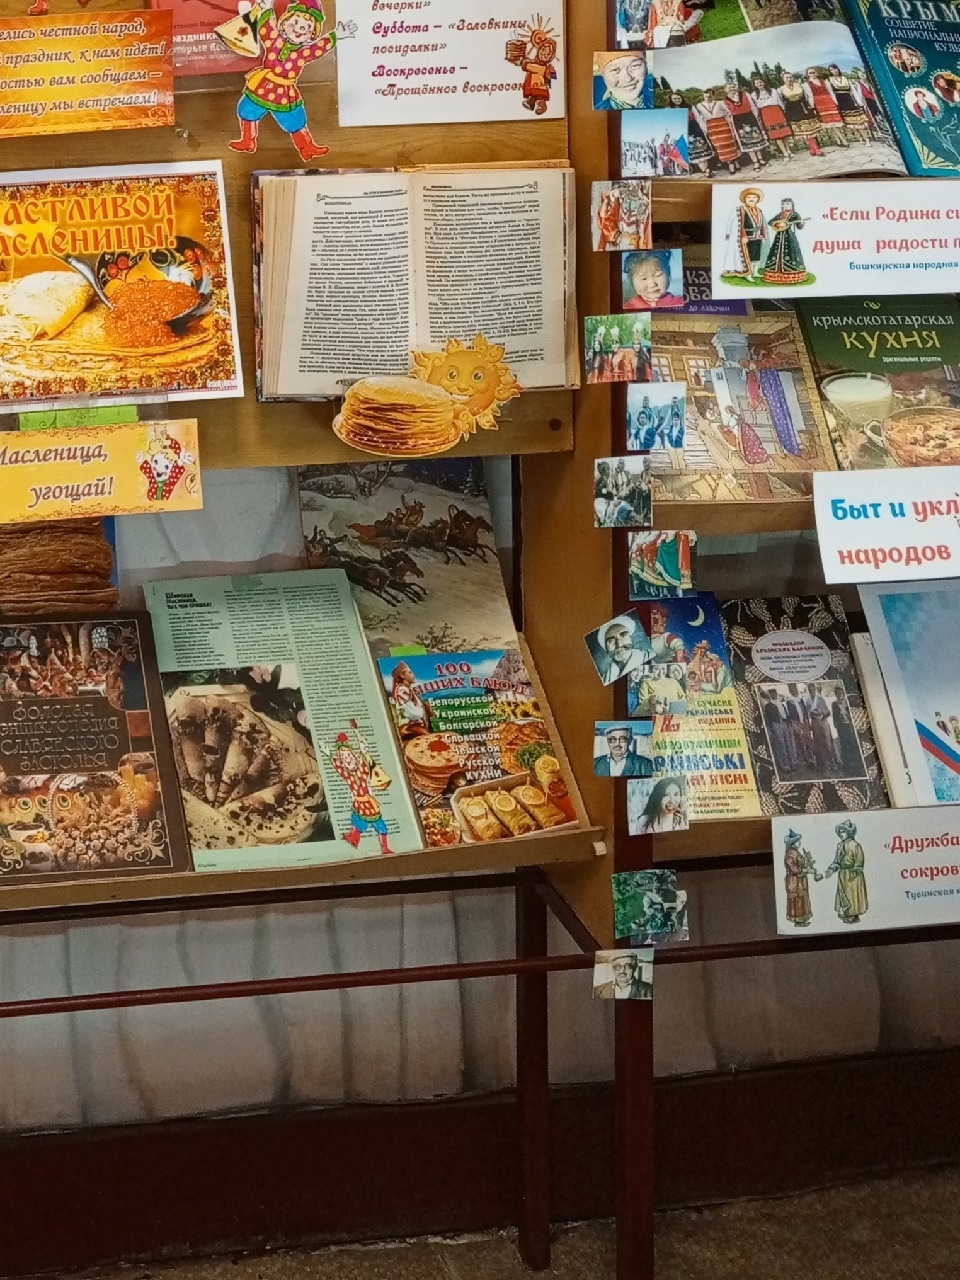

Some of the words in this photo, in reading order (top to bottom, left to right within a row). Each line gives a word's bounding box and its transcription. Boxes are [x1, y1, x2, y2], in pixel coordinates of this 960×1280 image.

[40, 21, 98, 38] честной
[102, 18, 146, 38] народ,
[372, 21, 429, 35] Суббота
[92, 48, 121, 59] нам
[125, 42, 165, 58] идёт!
[49, 77, 76, 87] вам
[80, 70, 147, 87] сообщаем
[372, 64, 456, 78] Воскресенье
[462, 81, 525, 94] воскресен
[50, 100, 74, 112] мы
[78, 92, 157, 112] встречаем!
[822, 207, 871, 221] «Если
[875, 206, 941, 221] Родина
[813, 237, 862, 254] душа
[876, 235, 948, 255] радости
[849, 261, 910, 271] Башкирская
[27, 476, 115, 508] угощай!
[830, 498, 883, 522] Быт
[889, 501, 906, 519] и
[837, 545, 952, 569] народов
[435, 662, 472, 675] 100
[429, 694, 494, 707] Белорусской
[434, 706, 496, 719] Украинской
[439, 720, 498, 731] Болгарской
[884, 832, 960, 854] «Дружба
